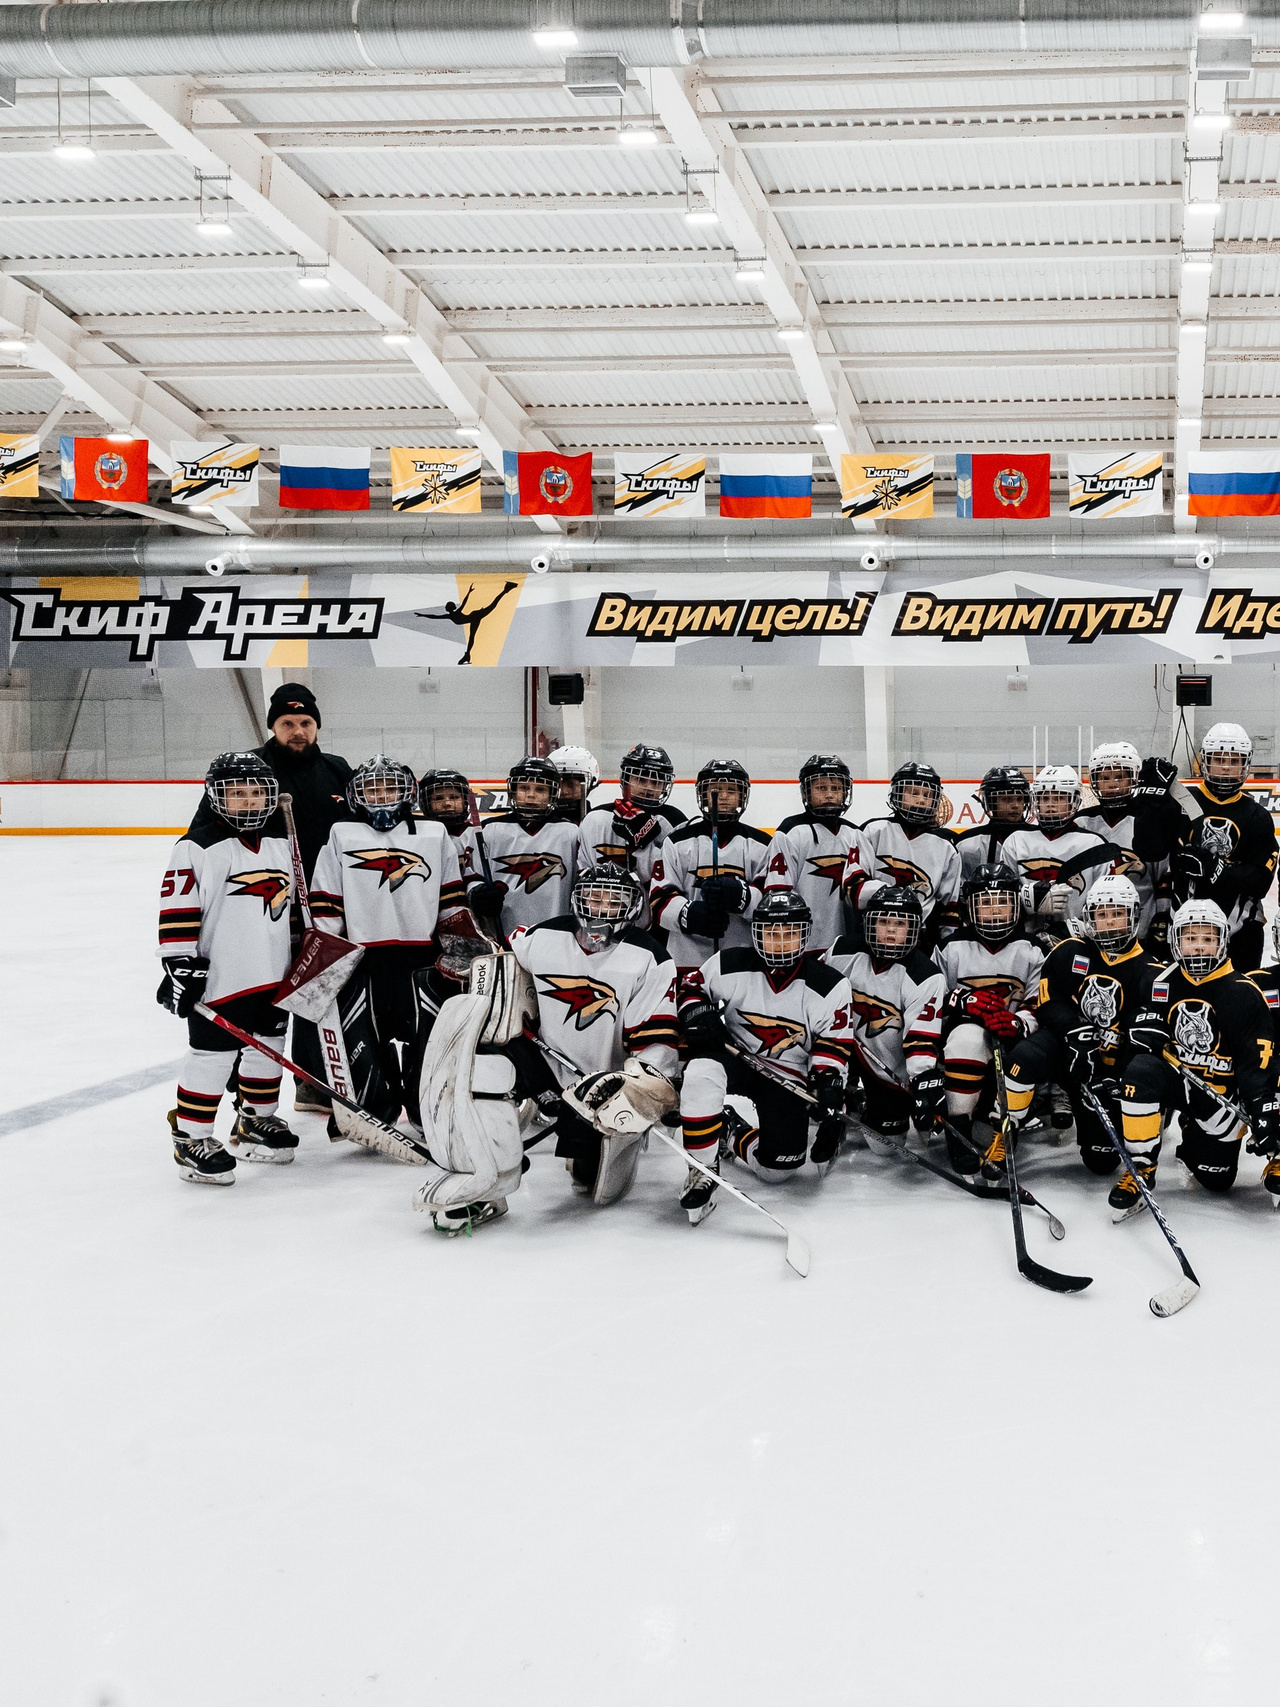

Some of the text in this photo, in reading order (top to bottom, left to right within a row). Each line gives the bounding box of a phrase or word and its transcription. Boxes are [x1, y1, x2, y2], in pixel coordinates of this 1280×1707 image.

[186, 463, 253, 488] Скифы
[415, 459, 457, 476] Скифы
[865, 467, 909, 482] Скифы
[625, 474, 701, 498] Скифы
[1080, 473, 1155, 496] Скифы
[11, 594, 170, 657] Скиф
[593, 594, 869, 637] Видим цель!
[900, 595, 1172, 638] Видим путь!
[160, 867, 197, 898] 57
[172, 967, 208, 978] CC
[290, 936, 322, 987] BAUER
[1135, 1012, 1164, 1023] BAU
[322, 1027, 348, 1098] BAUE
[1010, 1063, 1021, 1078] 10
[355, 1108, 416, 1150] BAUER
[1197, 1164, 1230, 1173] CCM
